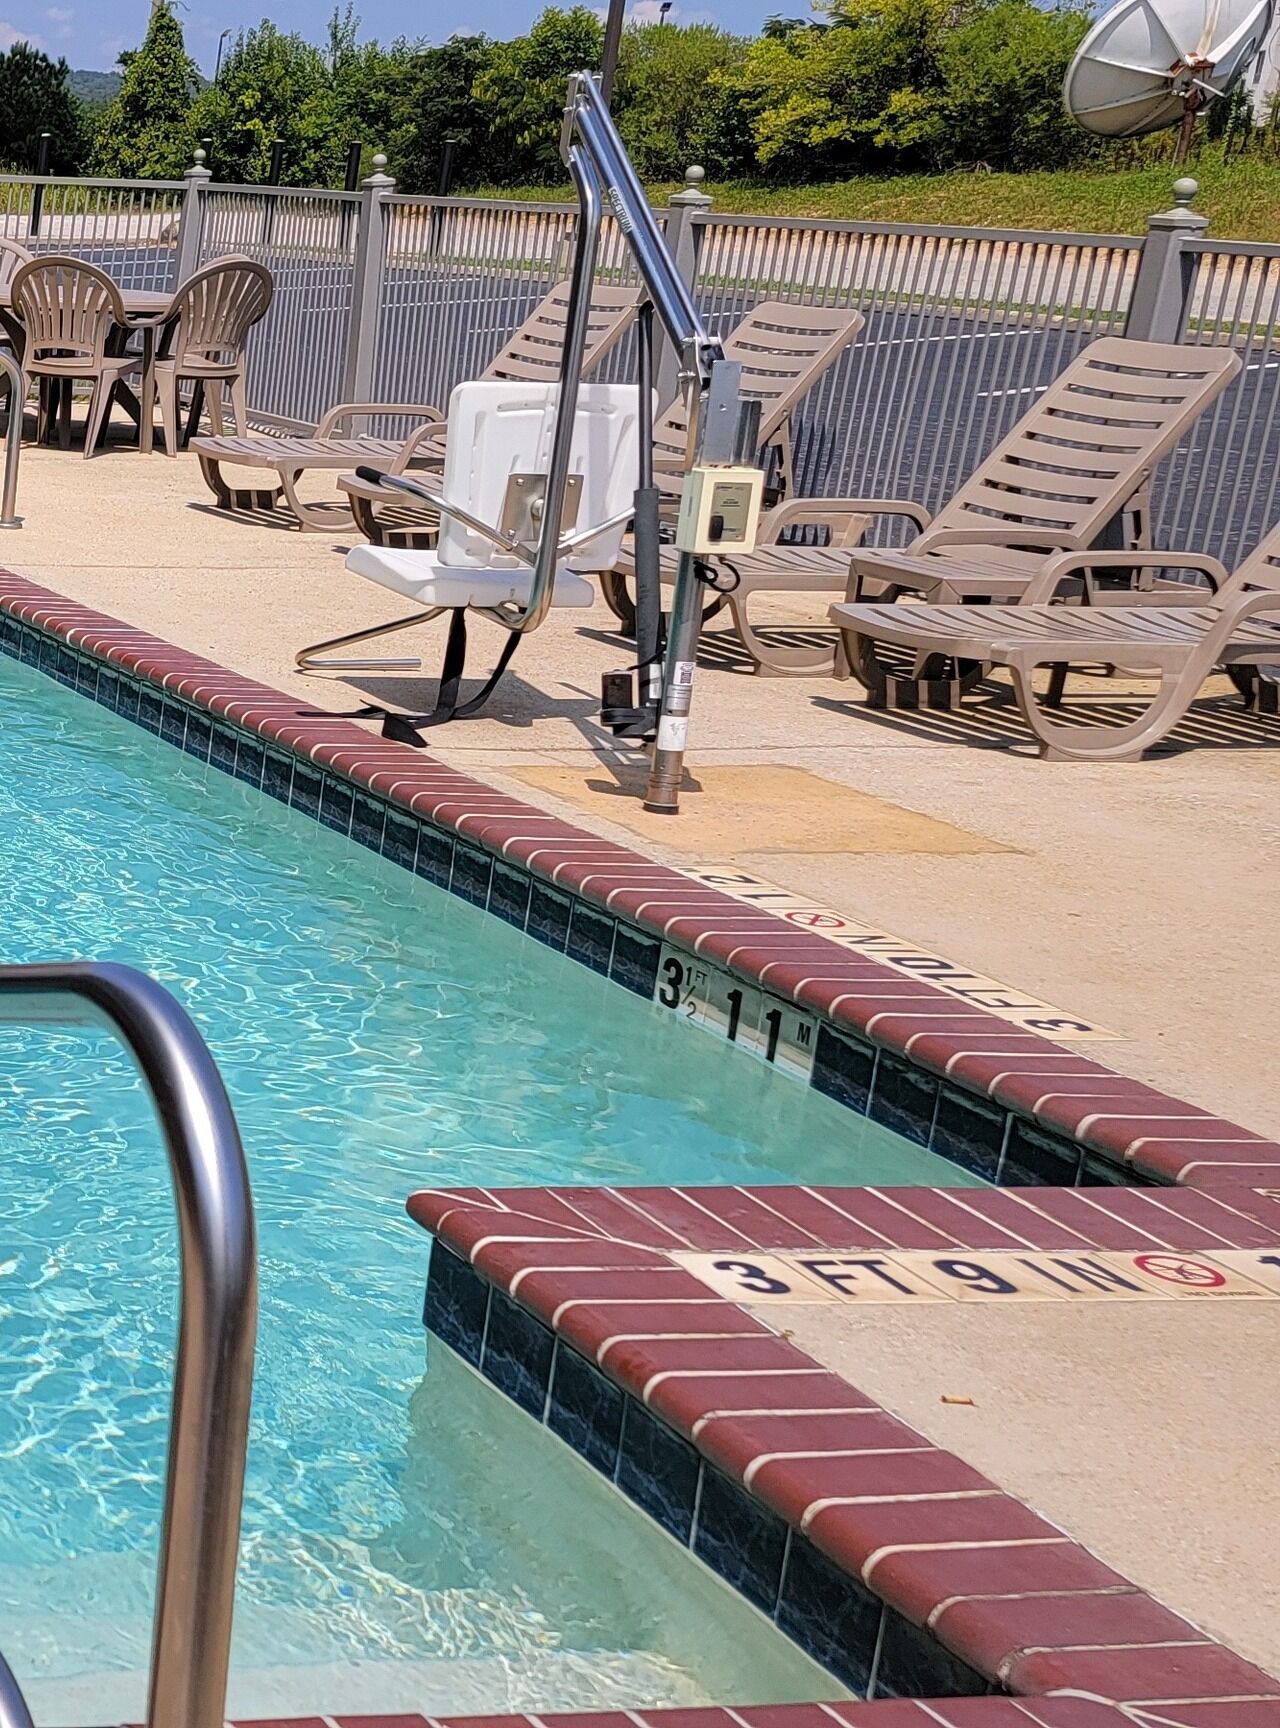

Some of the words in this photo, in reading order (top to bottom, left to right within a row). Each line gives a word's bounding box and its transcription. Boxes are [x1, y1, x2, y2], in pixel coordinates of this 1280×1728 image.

[832, 934, 922, 952] IN
[659, 957, 683, 1009] 3
[695, 969, 708, 986] FT
[796, 1021, 811, 1046] M
[941, 984, 1044, 1009] FT
[1023, 1018, 1094, 1032] 3
[712, 1260, 791, 1294] 3
[794, 1259, 919, 1295] FT
[932, 1259, 1019, 1294] 9
[1013, 1257, 1146, 1293] IN
